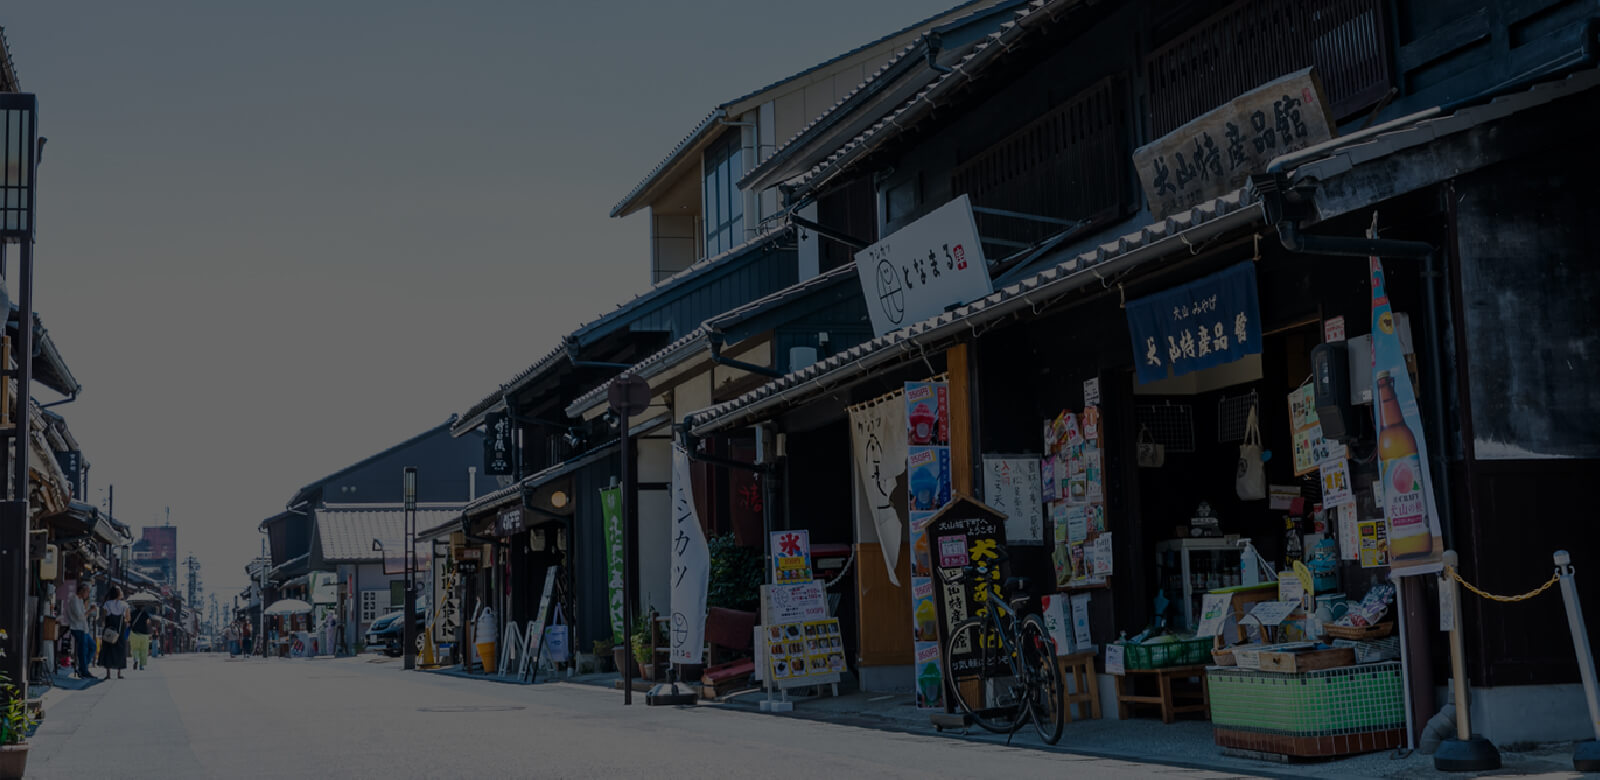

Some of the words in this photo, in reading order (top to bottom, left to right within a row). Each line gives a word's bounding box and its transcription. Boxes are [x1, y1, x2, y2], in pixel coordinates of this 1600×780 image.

[1153, 95, 1307, 196] 犬山特産品館
[902, 243, 954, 289] となまる
[1146, 311, 1248, 367] 犬山特産品館
[779, 532, 801, 557] 氷
